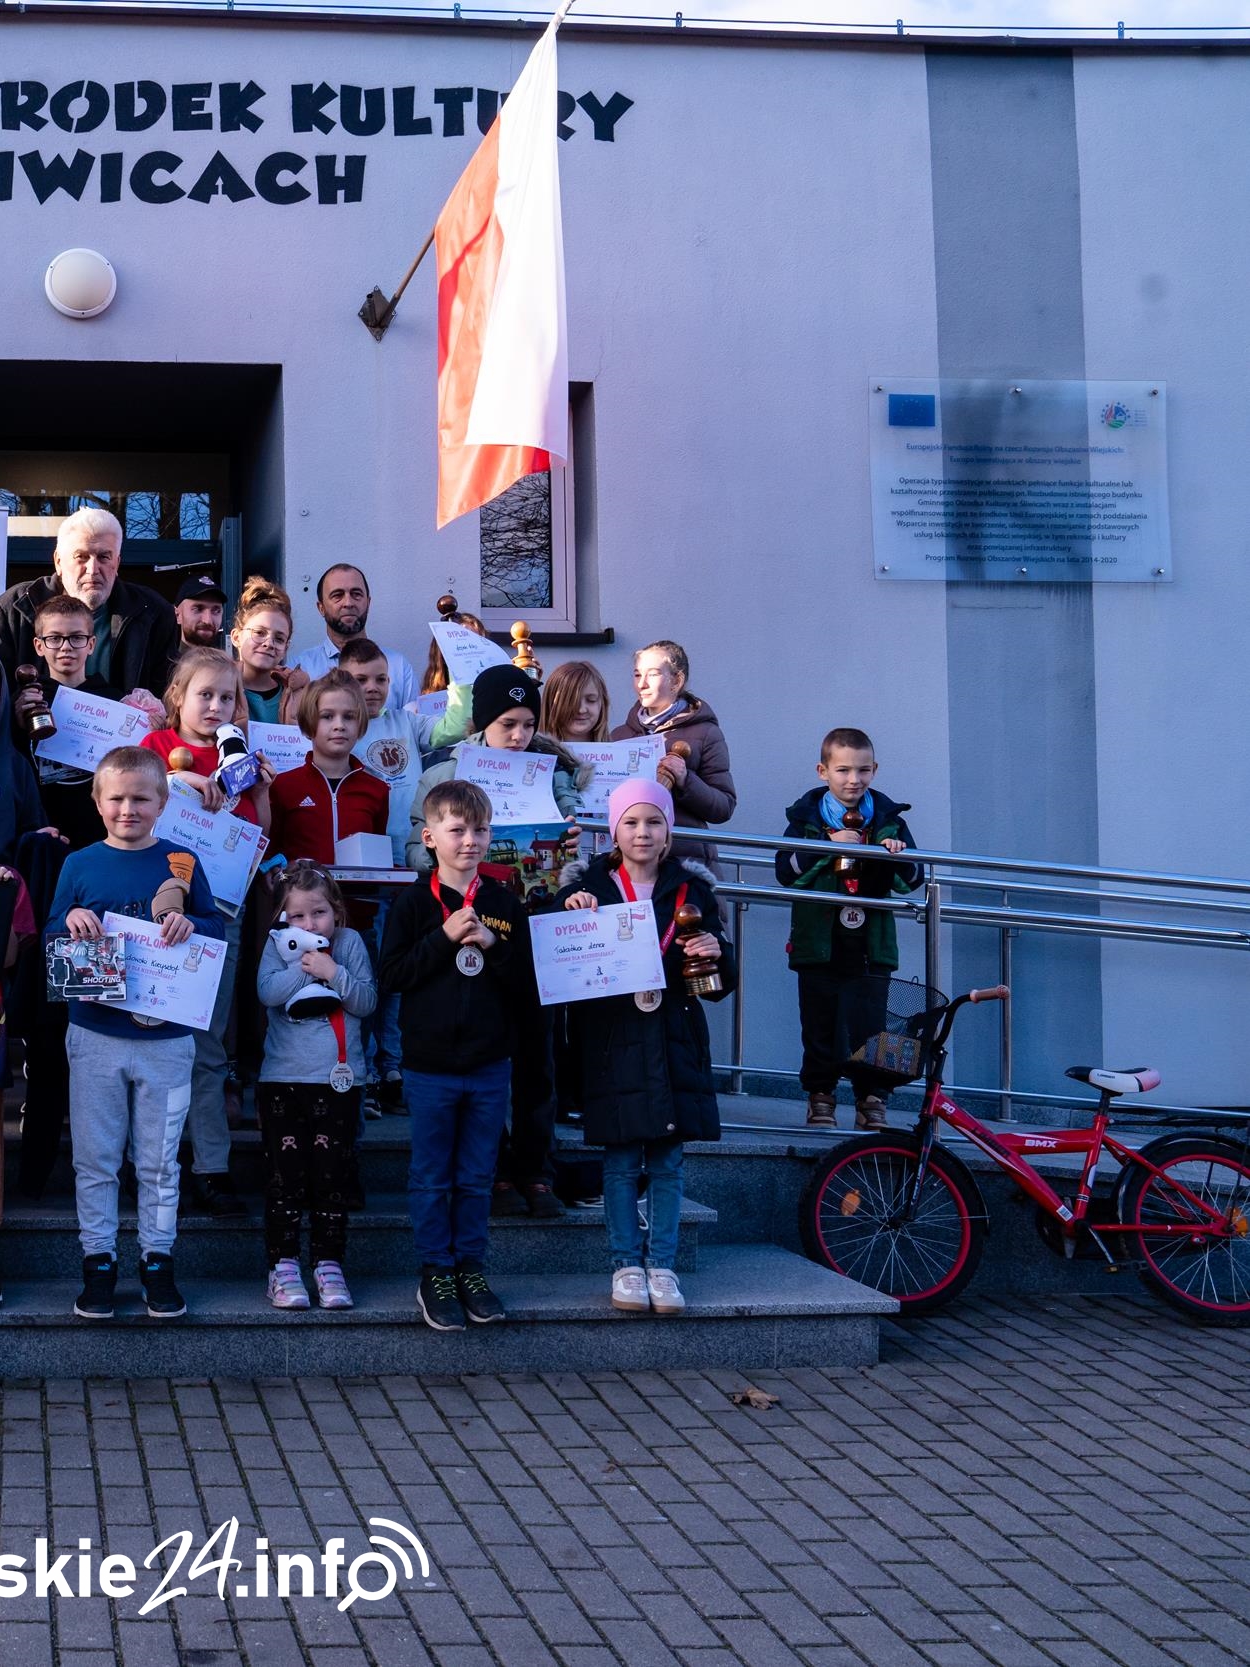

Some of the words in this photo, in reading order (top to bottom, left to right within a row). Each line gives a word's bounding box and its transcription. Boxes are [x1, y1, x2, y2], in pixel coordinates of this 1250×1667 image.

[899, 476, 930, 486] Operacja
[890, 487, 937, 496] kształtowanie
[1112, 491, 1142, 499] budynku
[918, 498, 954, 508] Gminnego
[985, 500, 1010, 508] Kultury
[1019, 500, 1051, 508] Śliwicach
[1076, 502, 1116, 510] instalacjami
[890, 510, 954, 518] współfinansowana
[1102, 512, 1148, 520] poddziałania
[896, 520, 927, 528] Wsparcie
[1087, 524, 1140, 532] podstawowych
[914, 531, 933, 539] usług
[1102, 534, 1126, 542] kultury
[1024, 544, 1072, 553] infrastruktury
[926, 554, 955, 562] Program
[1023, 556, 1055, 564] Wiejskich
[74, 702, 109, 719] DYPLOM
[267, 734, 301, 744] DYPLOM
[477, 758, 510, 770] DYPLOM
[180, 809, 214, 831] DYPLOM
[481, 914, 512, 932] BATMAN
[555, 921, 598, 936] DYPLOM
[126, 931, 170, 951] DYPLOM
[941, 1102, 956, 1114] 20
[1024, 1139, 1058, 1148] BMX
